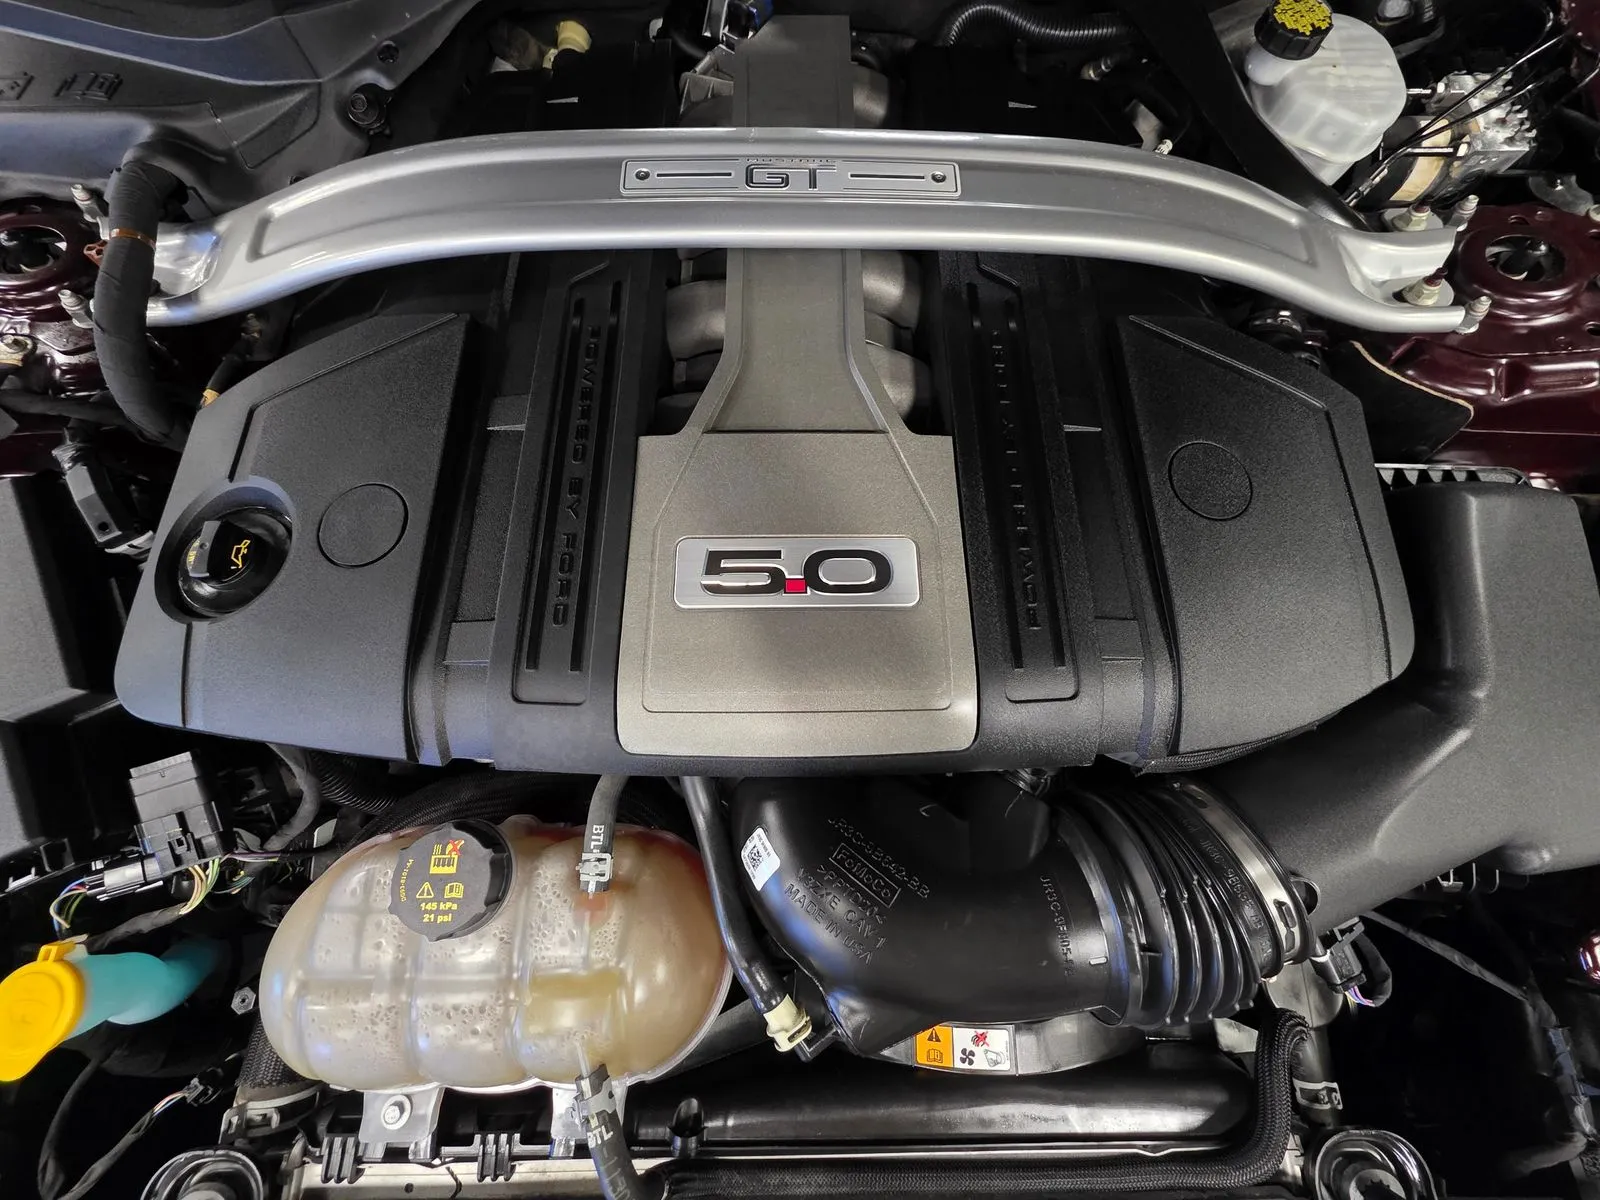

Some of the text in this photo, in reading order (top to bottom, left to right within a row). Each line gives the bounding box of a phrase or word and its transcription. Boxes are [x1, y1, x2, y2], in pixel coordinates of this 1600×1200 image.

[745, 163, 837, 190] GT
[553, 325, 601, 627] POWERED BY FORD
[701, 548, 894, 596] 5.0
[836, 849, 892, 899] FoMoCo
[420, 901, 458, 911] 145 kPa
[422, 913, 452, 924] 21 psi
[784, 883, 874, 966] MADE IN USA
